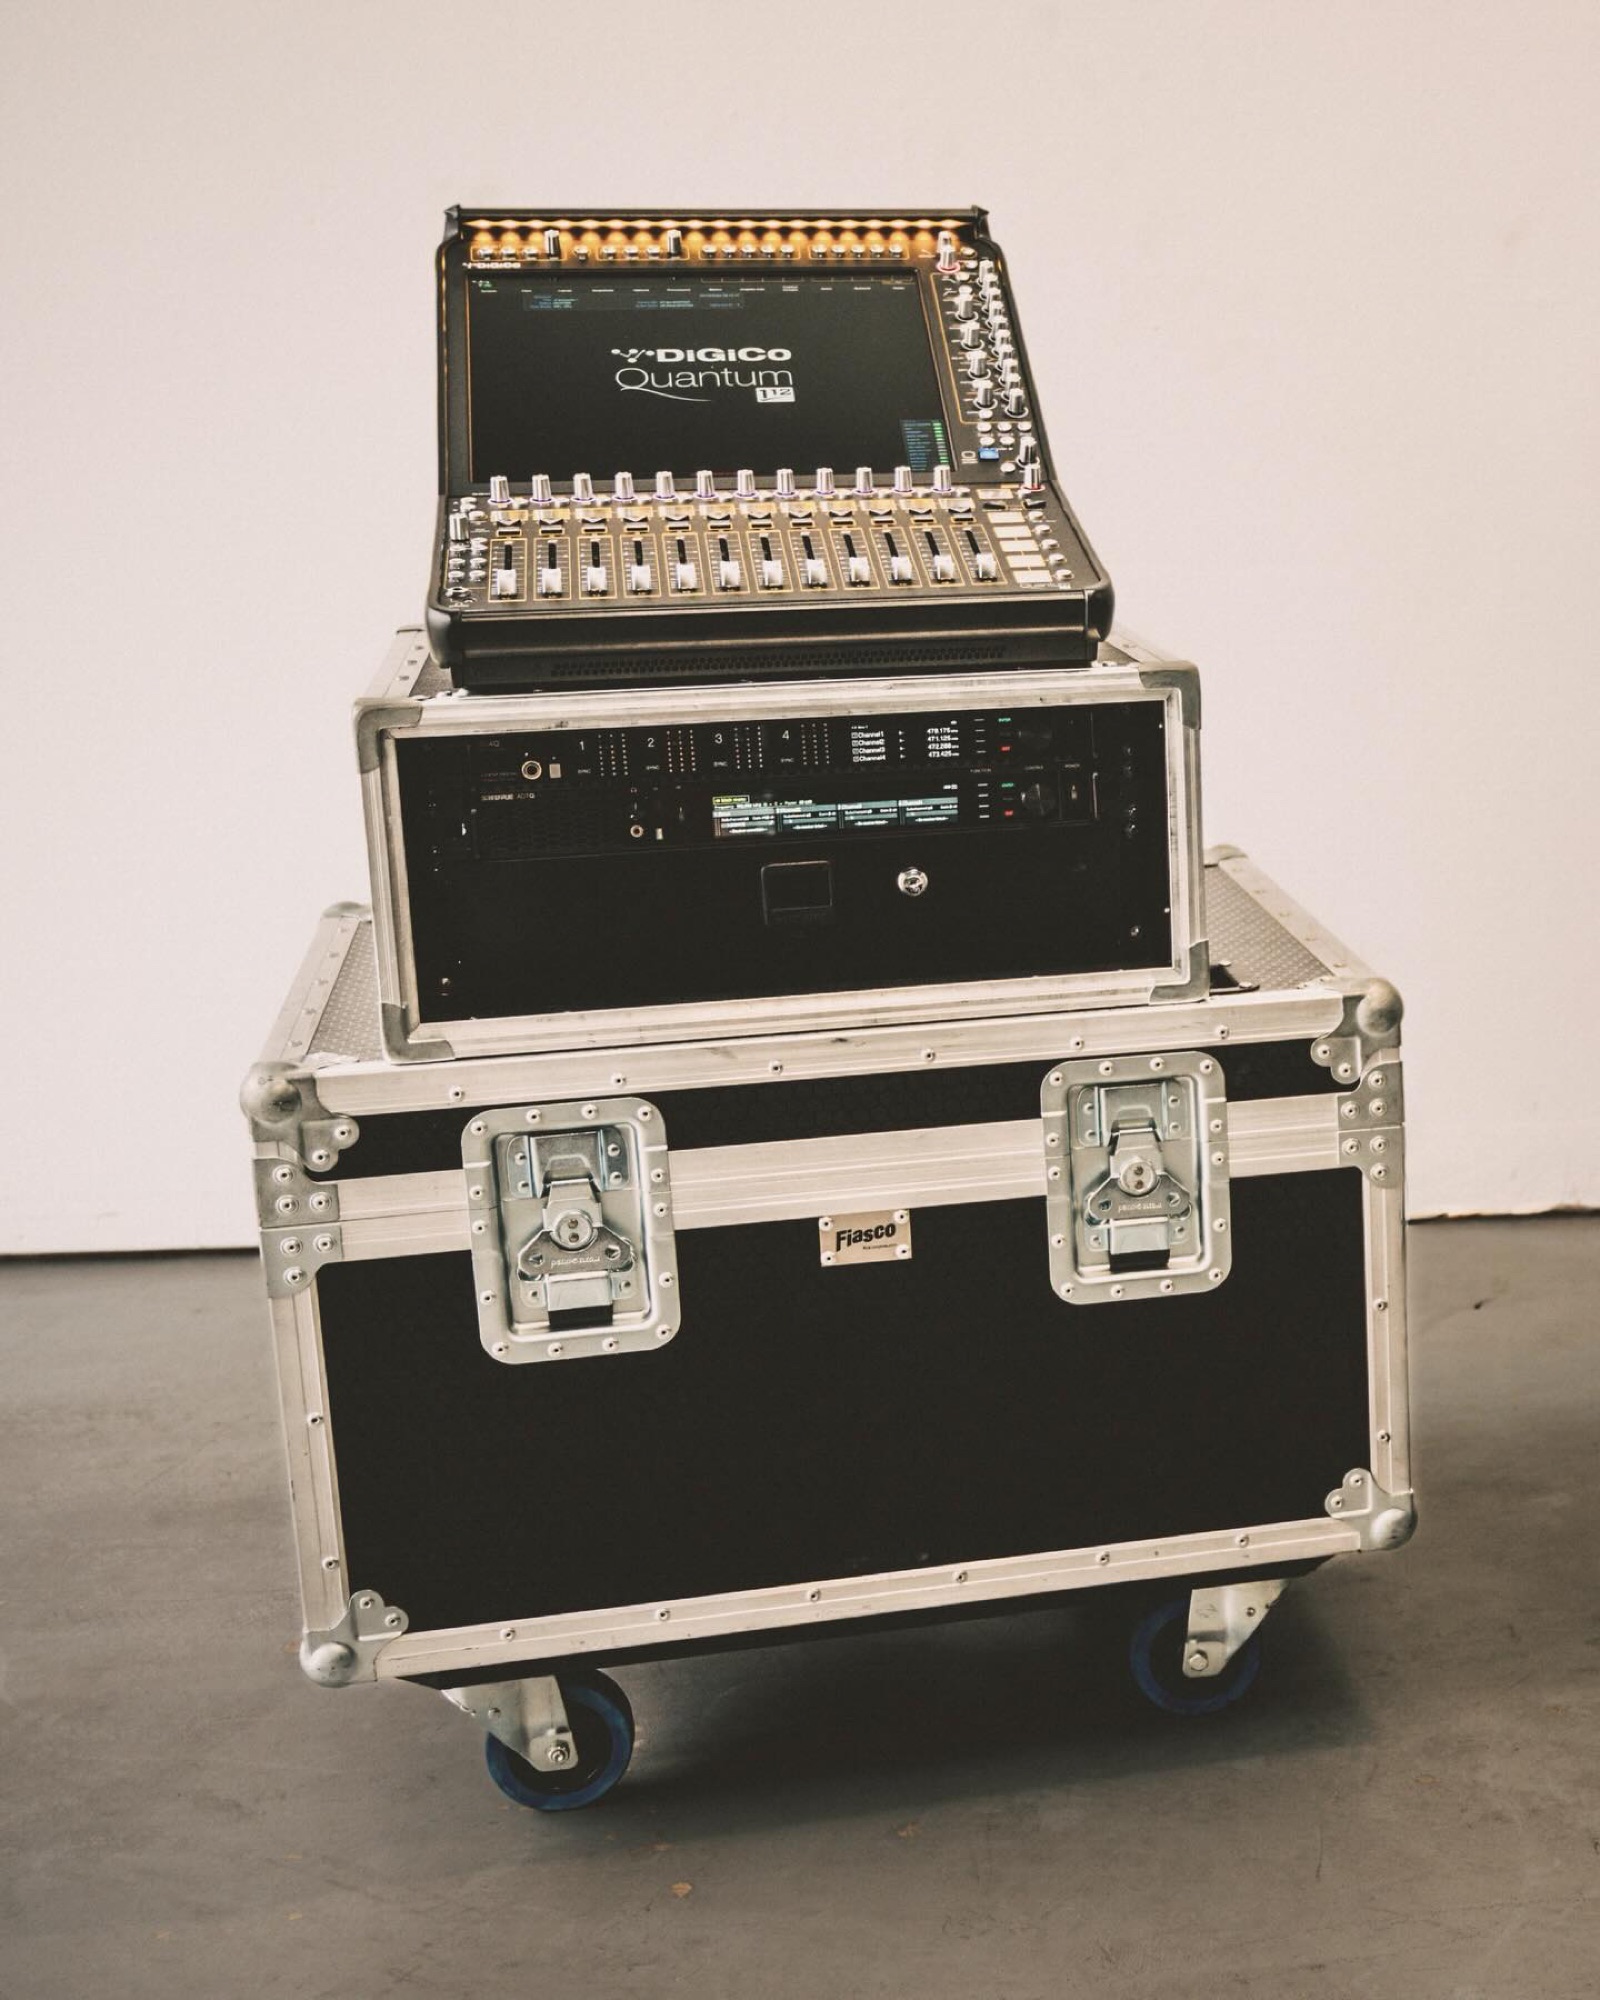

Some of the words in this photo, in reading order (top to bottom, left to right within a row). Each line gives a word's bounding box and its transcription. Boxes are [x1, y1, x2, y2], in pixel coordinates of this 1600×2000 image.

[615, 367, 793, 400] Quantum
[714, 733, 723, 744] 3
[782, 730, 790, 740] 4
[580, 741, 585, 751] 1
[647, 737, 656, 748] 2
[836, 1223, 896, 1252] Fiasco
